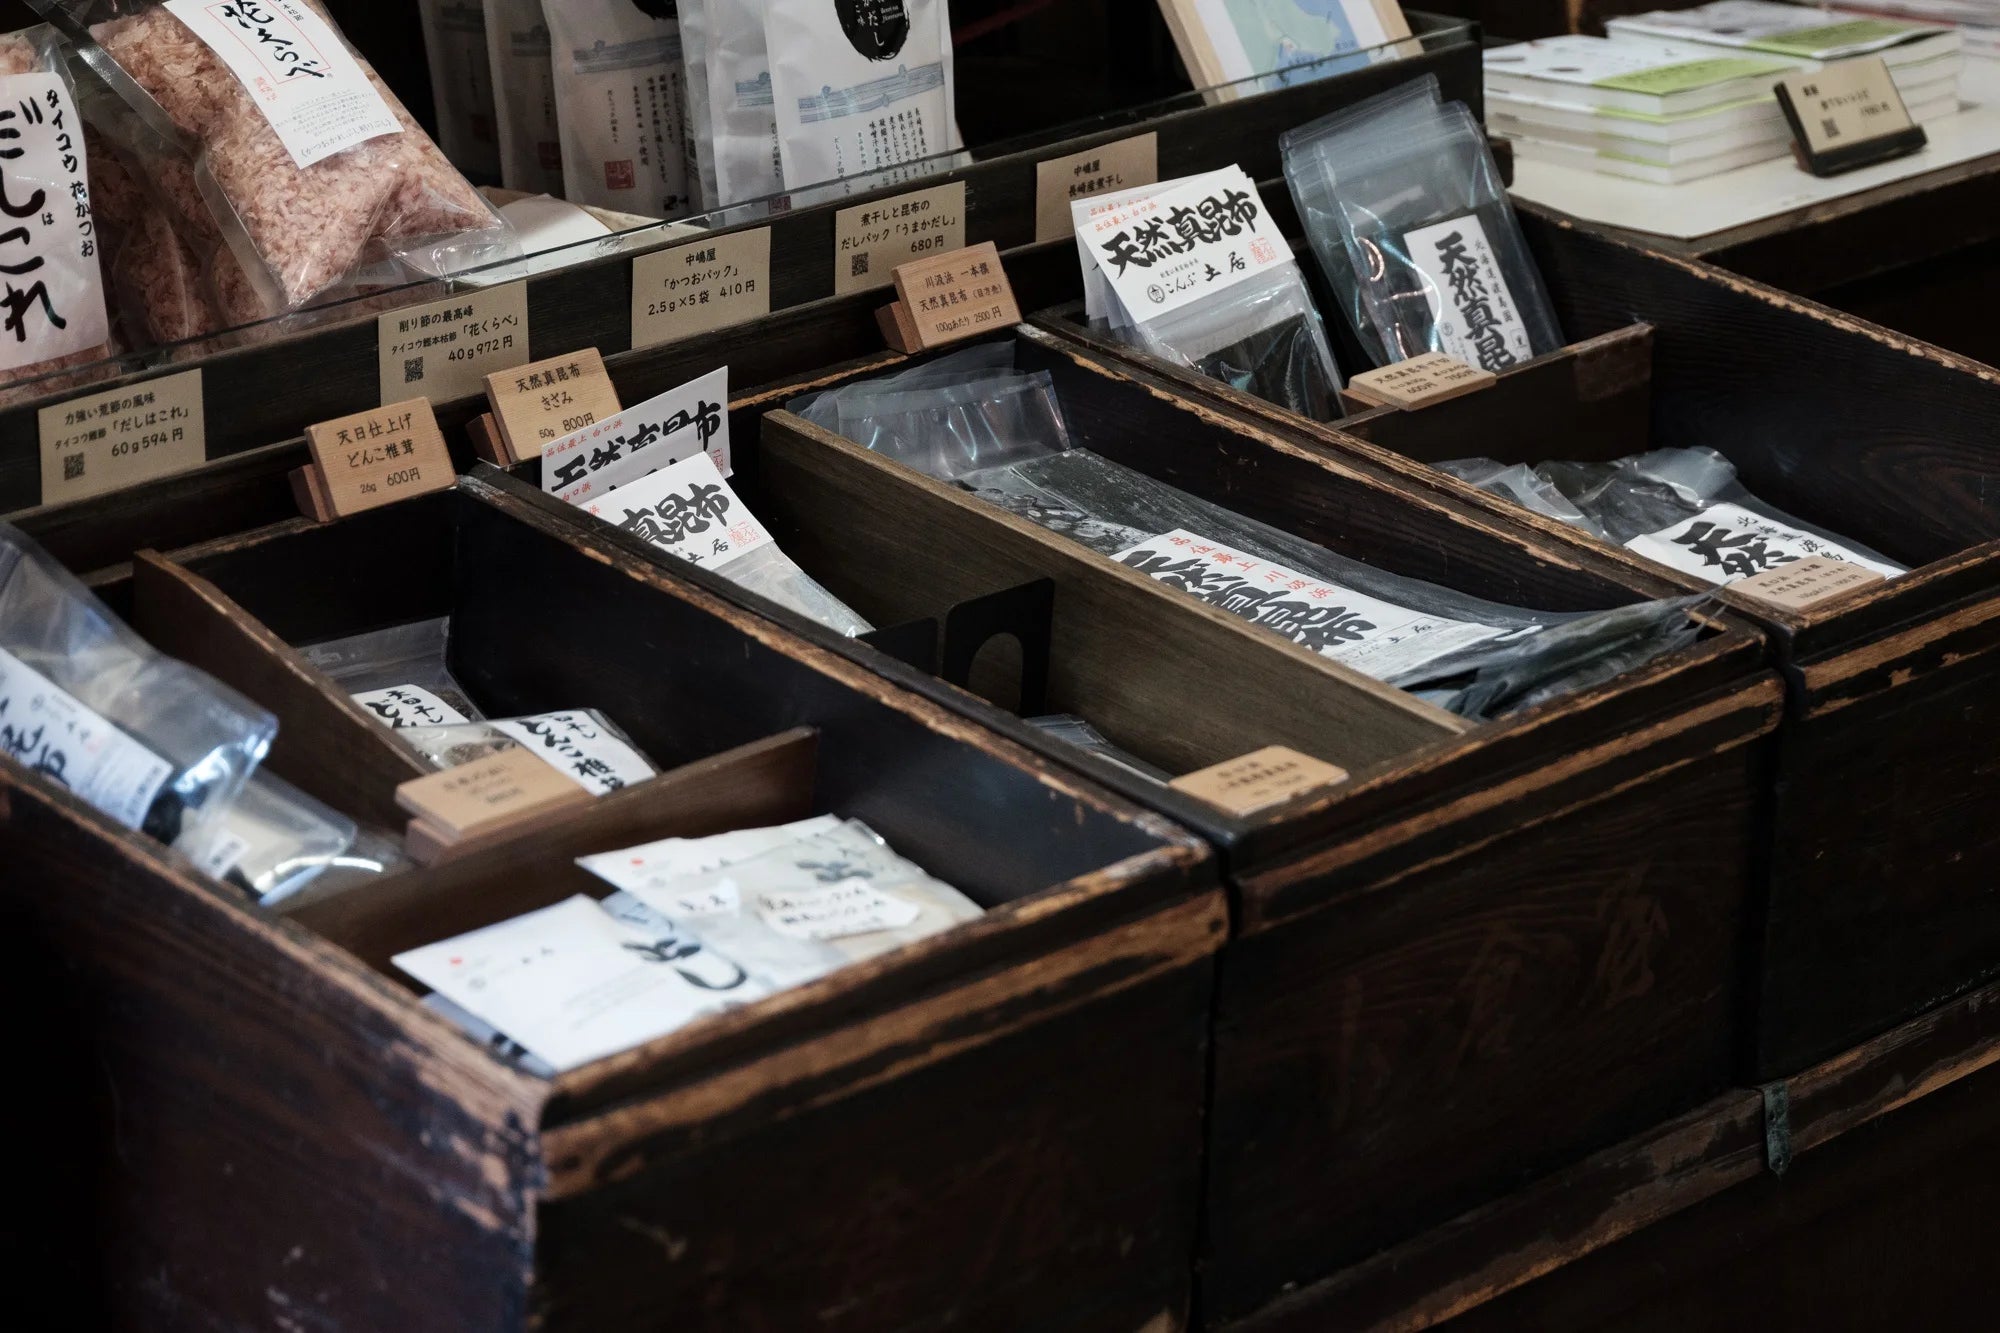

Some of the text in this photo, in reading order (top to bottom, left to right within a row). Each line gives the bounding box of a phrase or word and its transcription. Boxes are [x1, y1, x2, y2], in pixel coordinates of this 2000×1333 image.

[861, 200, 931, 227] 煮干しと昆布の
[911, 235, 944, 253] 680円
[1101, 188, 1258, 280] 天然真昆布
[685, 247, 717, 267] 中嶋屋
[720, 279, 755, 297] 410円
[399, 305, 474, 333] 削り節の最高峰
[515, 362, 581, 393] 天然真昆布
[541, 391, 574, 411] きざみ
[337, 413, 412, 446] 天日仕上げ
[562, 412, 595, 432] 800円
[347, 439, 415, 468] どんこ椎茸
[387, 467, 421, 486] 600円
